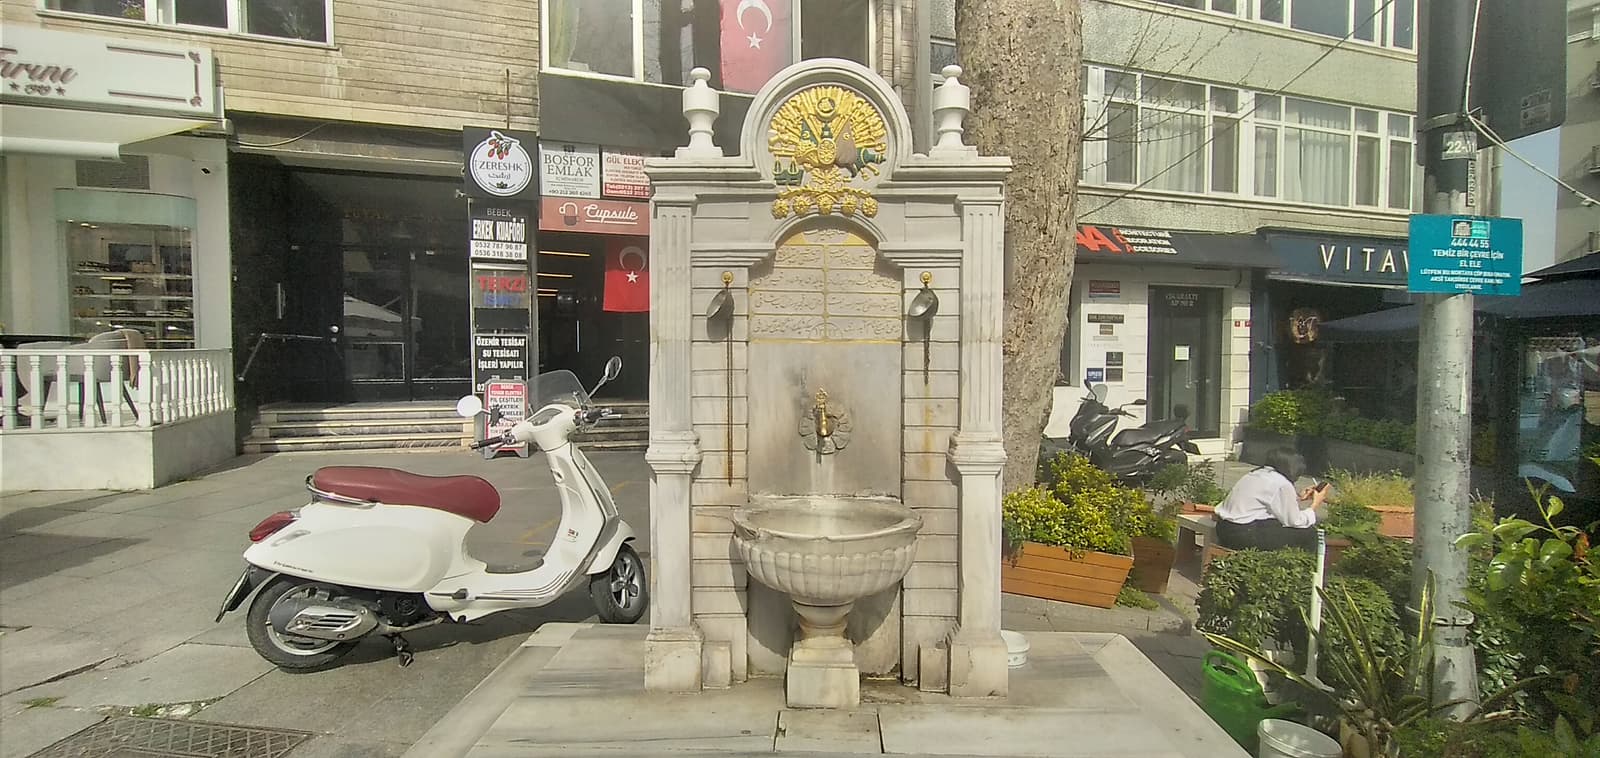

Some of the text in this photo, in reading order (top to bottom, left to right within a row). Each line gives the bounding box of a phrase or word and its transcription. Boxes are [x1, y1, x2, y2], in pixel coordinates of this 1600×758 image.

[544, 154, 594, 168] BOSFOR
[606, 155, 621, 164] GÜL
[479, 160, 524, 172] ZERESHK
[548, 164, 592, 178] EMLAK
[486, 208, 512, 217] BEBEK
[584, 204, 638, 223] Cupsule
[473, 220, 494, 240] ERKEK
[1450, 238, 1490, 248] 444 44 55
[1432, 248, 1456, 257] TEMİZ
[1457, 248, 1469, 258] BİR
[482, 350, 492, 358] SU
[478, 358, 524, 371] İŞLERİ YAPILIR
